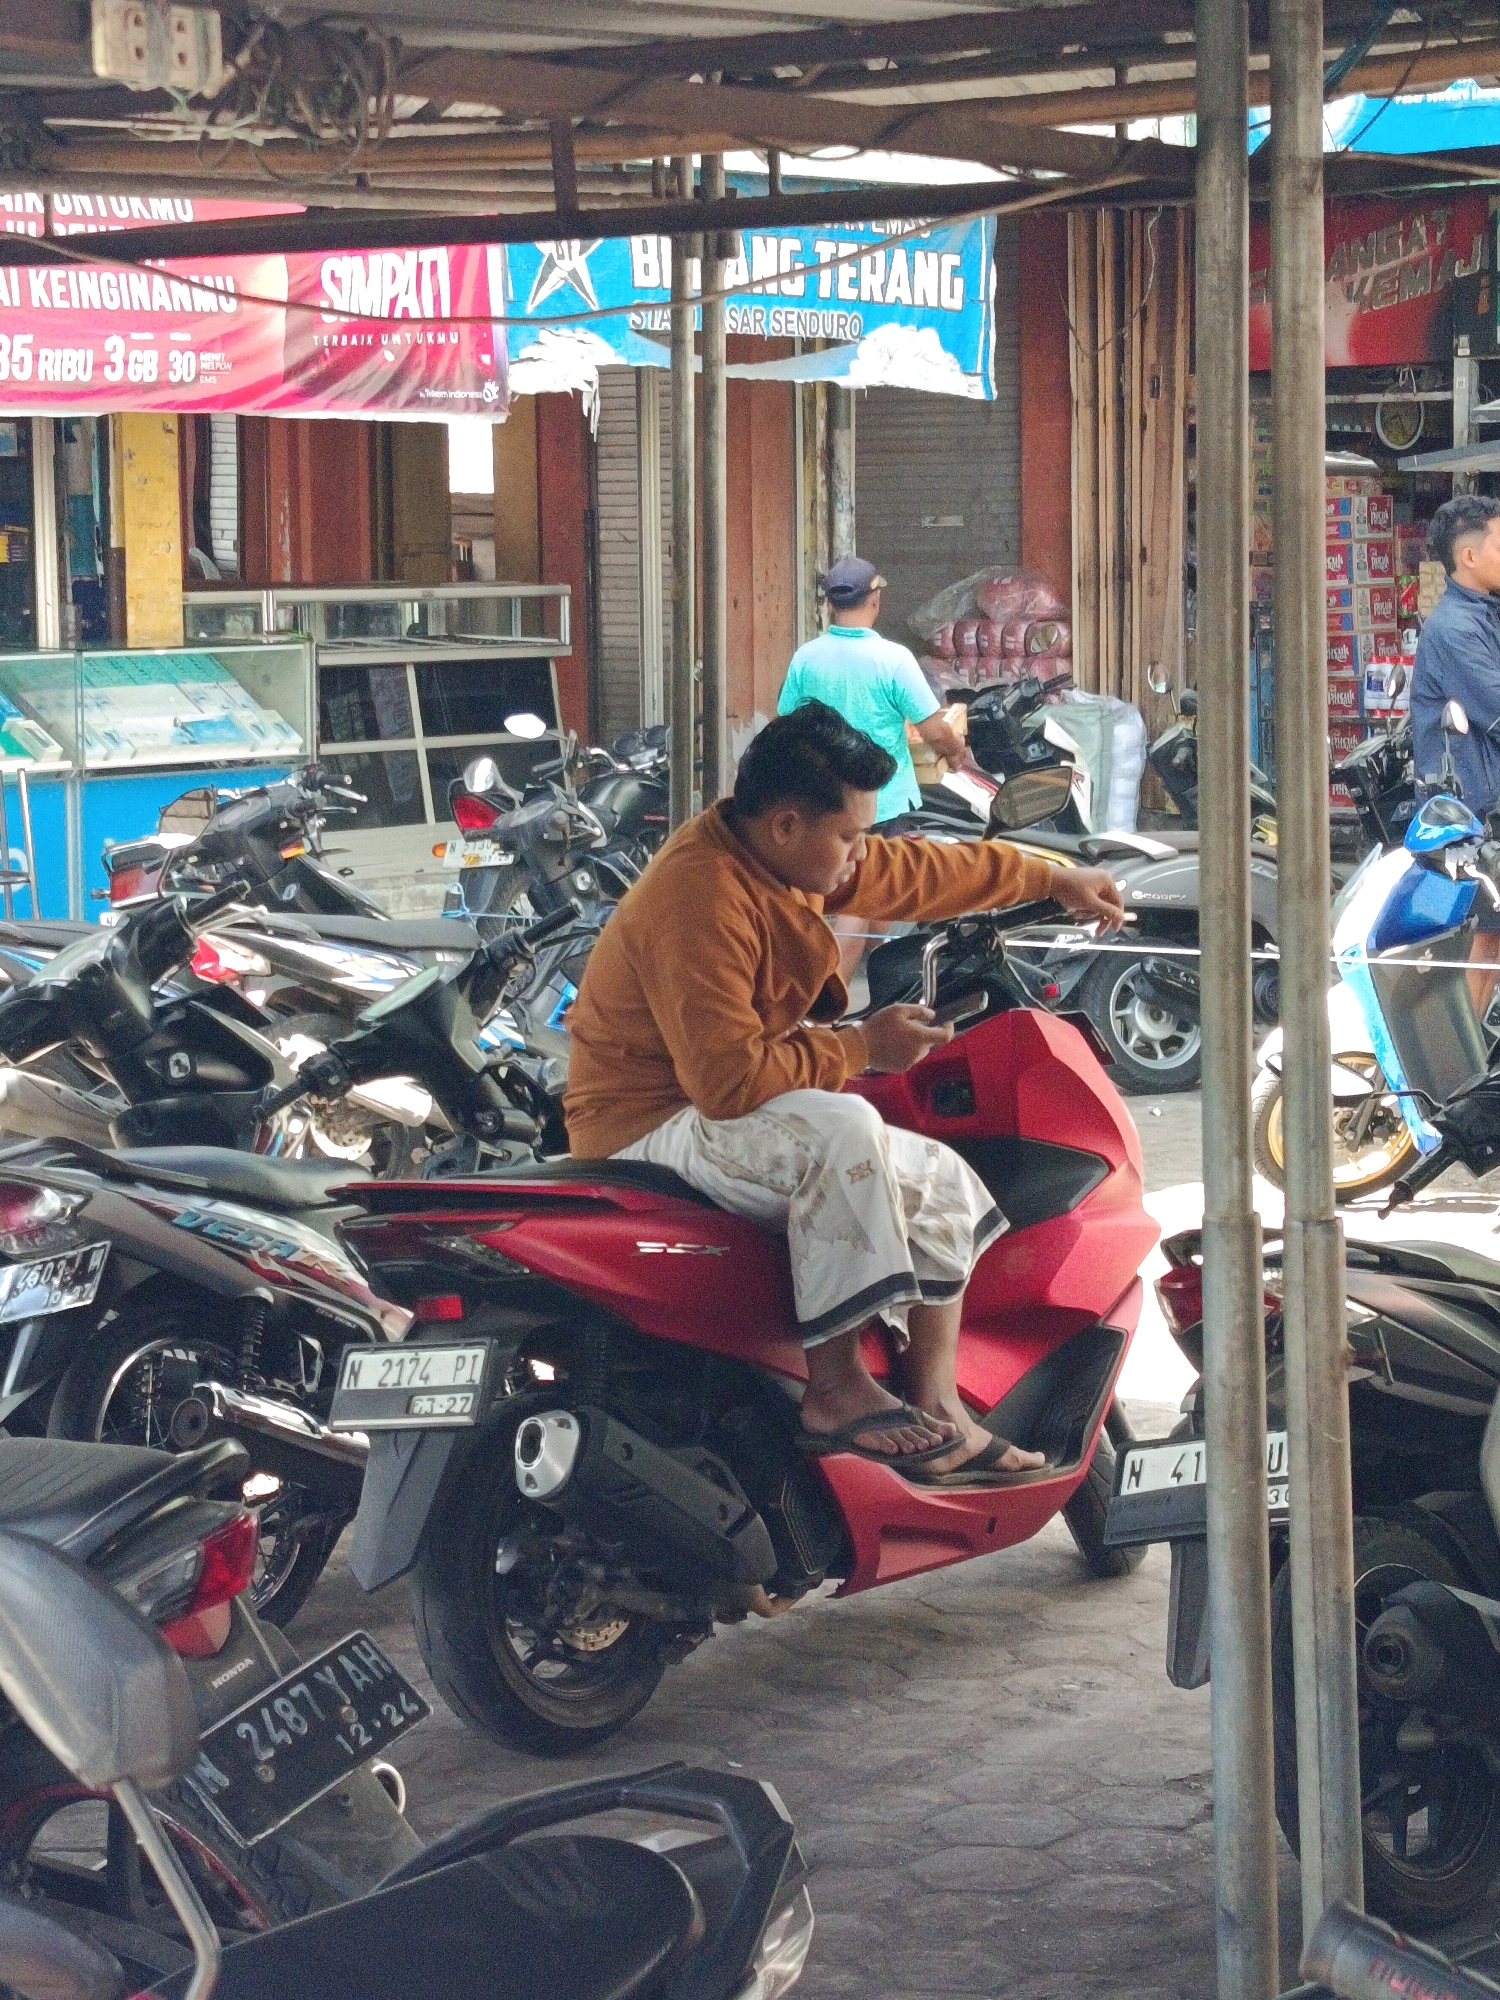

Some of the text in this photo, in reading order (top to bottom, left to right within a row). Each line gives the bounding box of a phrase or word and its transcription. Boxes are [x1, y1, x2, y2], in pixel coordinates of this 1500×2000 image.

[28, 268, 238, 313] KEINGINANMU
[320, 246, 450, 323] SIMPATI
[630, 234, 965, 311] BIANG TERANG
[313, 331, 460, 346] TERBAIK UNTUKMU
[771, 309, 863, 338] SENDURO
[38, 348, 94, 382] RIBU
[103, 334, 126, 382] 3
[127, 350, 159, 382] GB
[168, 350, 196, 382] 30
[346, 1354, 479, 1389] N 2174 PI
[1127, 1458, 1143, 1490] N
[211, 1658, 254, 1688] HONDA
[194, 1752, 230, 1794] N
[236, 1683, 327, 1761] 2487
